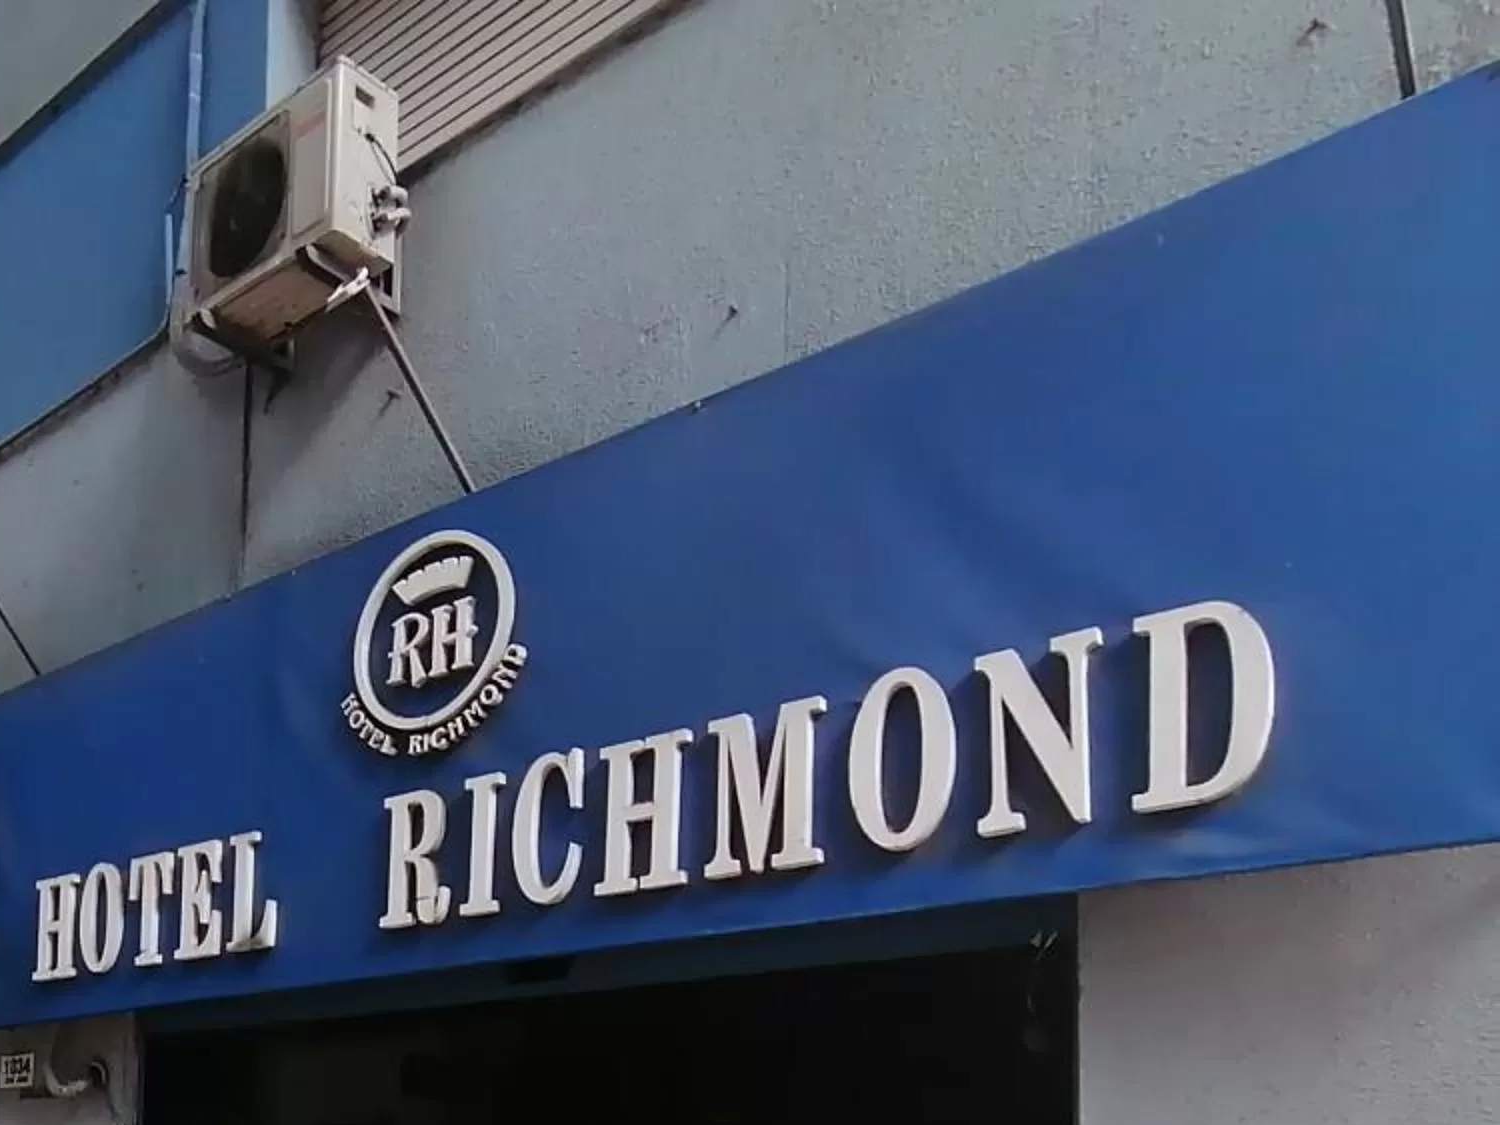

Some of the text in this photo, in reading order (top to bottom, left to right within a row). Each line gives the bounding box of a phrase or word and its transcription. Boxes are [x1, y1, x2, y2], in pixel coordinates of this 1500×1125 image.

[385, 595, 479, 688] RH
[339, 643, 529, 757] HOTEL RICHMOND
[31, 600, 1276, 984] HOTEL RICHMOND
